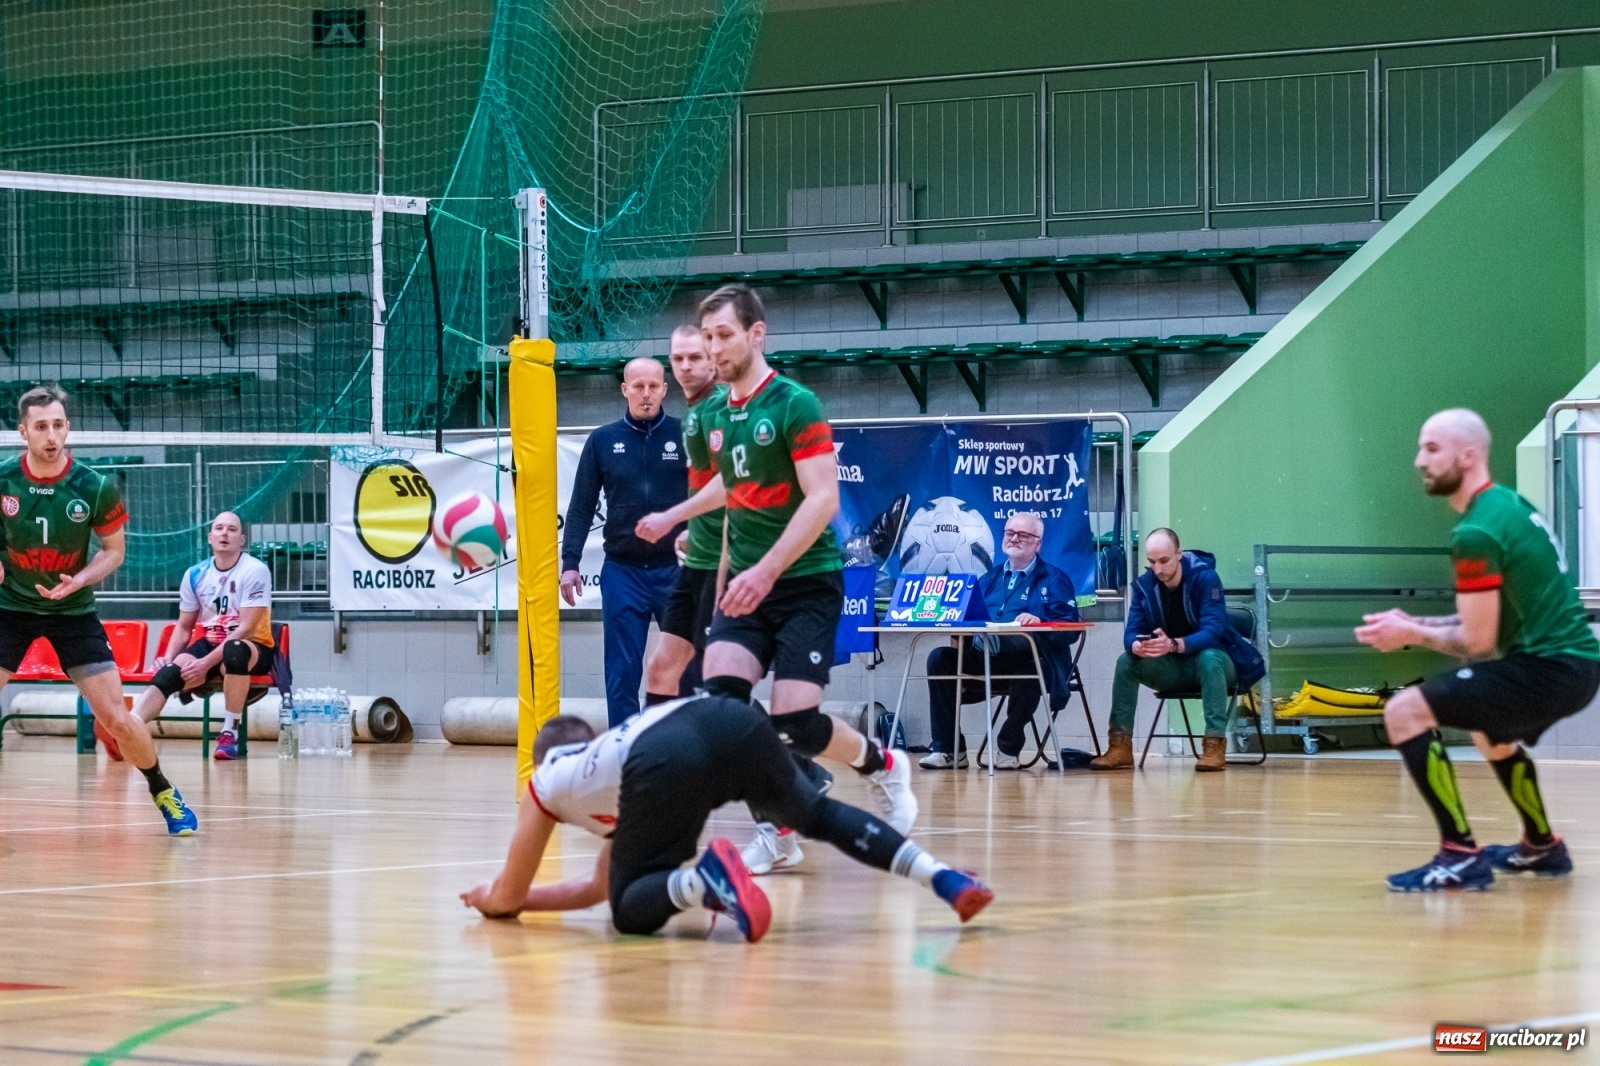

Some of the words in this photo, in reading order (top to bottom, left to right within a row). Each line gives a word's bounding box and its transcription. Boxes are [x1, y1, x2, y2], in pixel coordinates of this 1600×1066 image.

[322, 23, 357, 43] A
[958, 439, 984, 452] Sklep
[985, 441, 1025, 453] sportowy
[731, 444, 750, 478] 12
[953, 455, 989, 475] MW
[994, 454, 1060, 475] SPORT
[836, 464, 864, 482] ma
[992, 484, 1062, 502] Racibórz
[994, 509, 1006, 519] ul.
[1007, 508, 1048, 519] China
[1049, 507, 1063, 518] 17
[35, 517, 48, 545] 7
[353, 565, 436, 589] RACIBÓRZ
[902, 580, 920, 603] 11
[923, 579, 933, 594] 0
[935, 579, 945, 594] 0
[944, 580, 964, 602] 12
[213, 595, 228, 615] 19
[841, 596, 868, 615] ten
